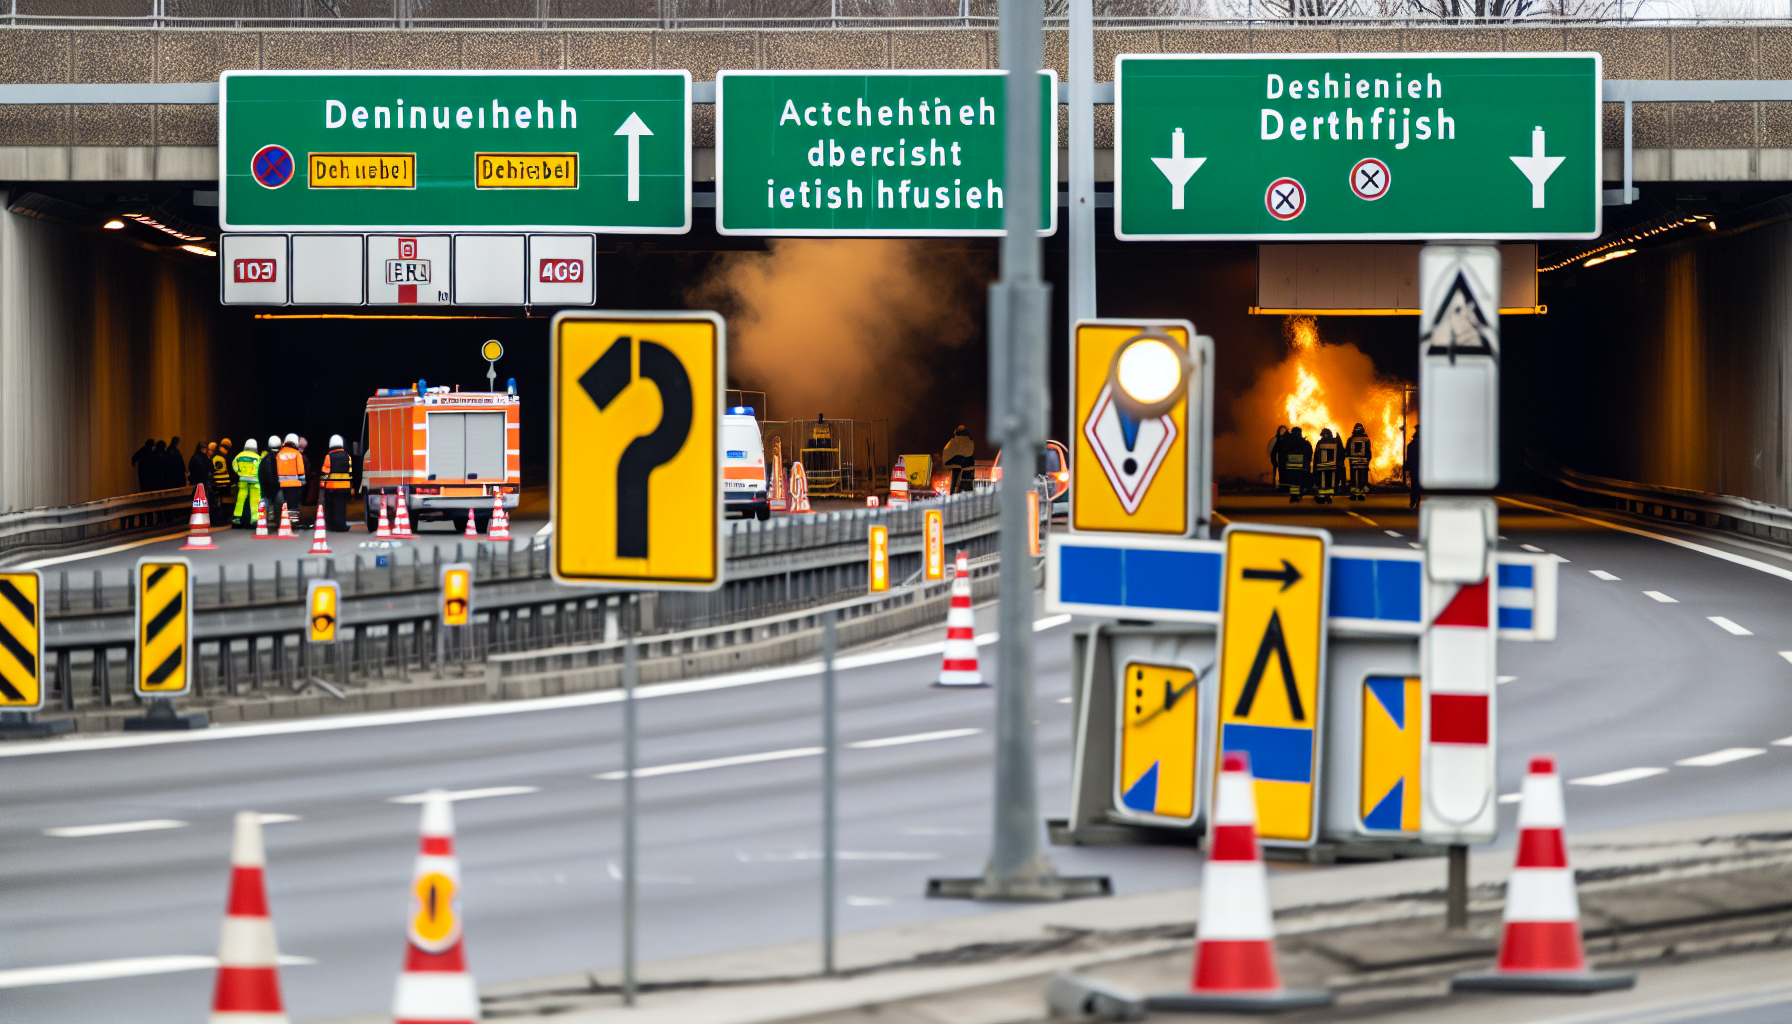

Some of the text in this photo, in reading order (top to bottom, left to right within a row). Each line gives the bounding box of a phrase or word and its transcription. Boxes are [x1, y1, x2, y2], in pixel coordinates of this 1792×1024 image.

[1266, 73, 1442, 99] Deshienieh
[1260, 107, 1455, 150] Derthfijsh
[807, 138, 962, 167] dbercisht
[767, 178, 1004, 209] ietish hfusieh
